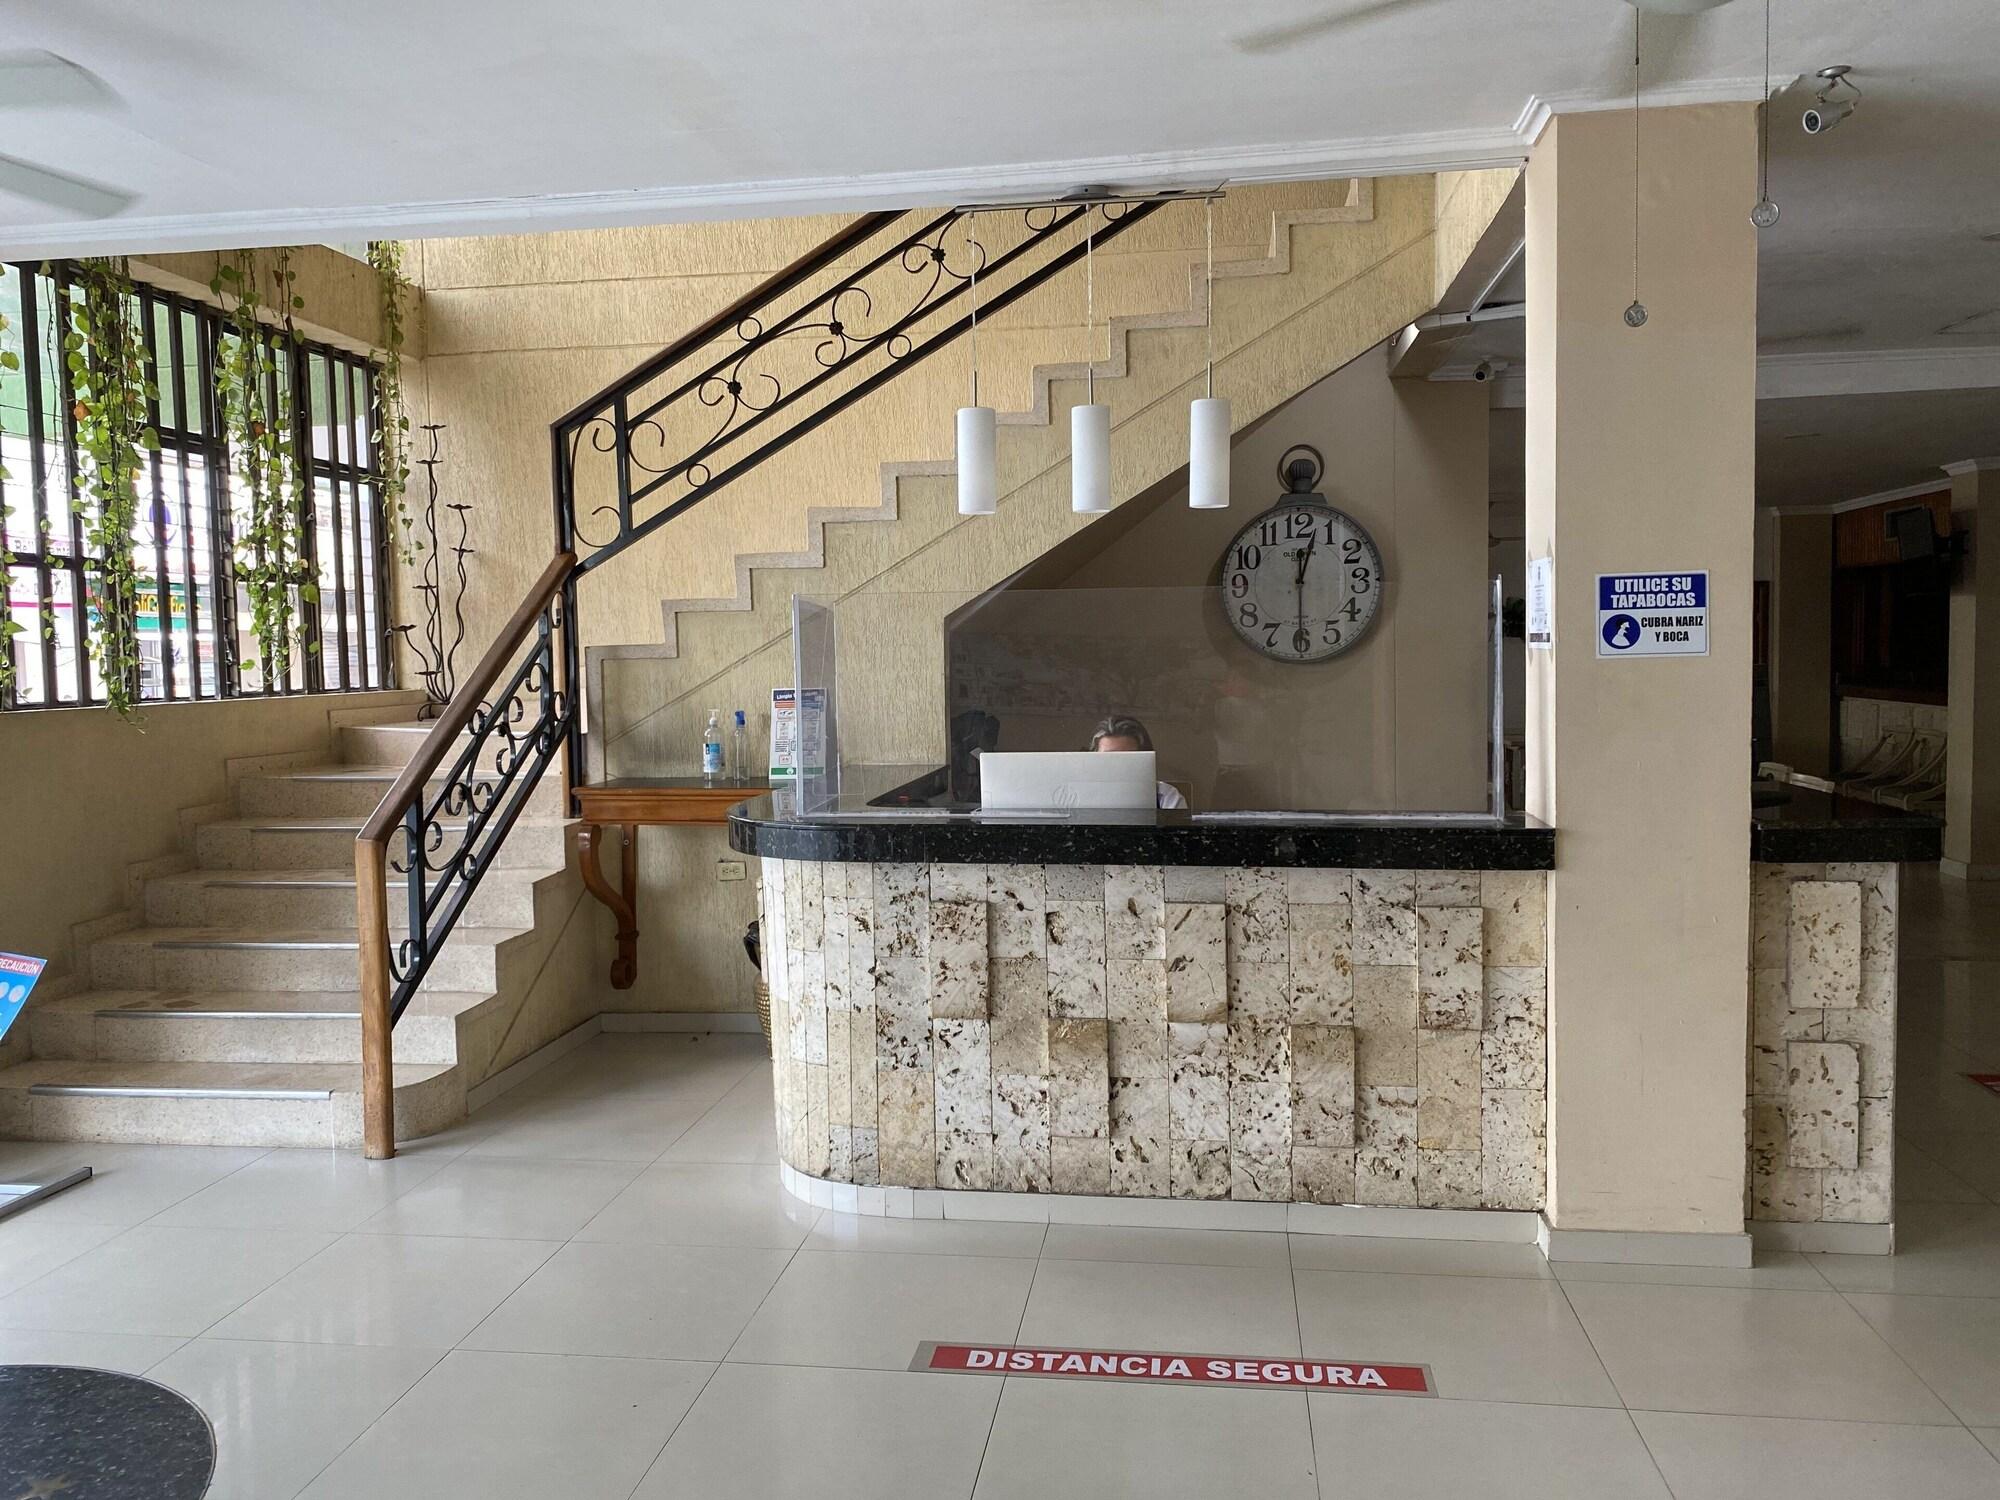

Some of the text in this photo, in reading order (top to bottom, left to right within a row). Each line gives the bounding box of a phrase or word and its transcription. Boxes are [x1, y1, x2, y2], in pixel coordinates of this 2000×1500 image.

[1259, 521, 1277, 546] 11
[1284, 513, 1314, 539] 12
[1324, 520, 1336, 545] 1
[1235, 545, 1261, 570] 10
[1342, 539, 1362, 564] 2
[1231, 574, 1248, 598] 9
[1351, 567, 1369, 594] 3
[1615, 577, 1692, 592] UTILICE SU
[1339, 597, 1361, 621] 4
[1610, 593, 1696, 608] TAPABOCAS
[1239, 603, 1258, 627] 8
[1641, 615, 1704, 628] CUBRA NARIZ
[1262, 623, 1282, 647] 7
[1292, 628, 1310, 653] 6
[1323, 620, 1341, 644] 5
[1655, 631, 1690, 642] Y BOCA
[966, 1349, 1390, 1387] DISTANCIA SEGURA
